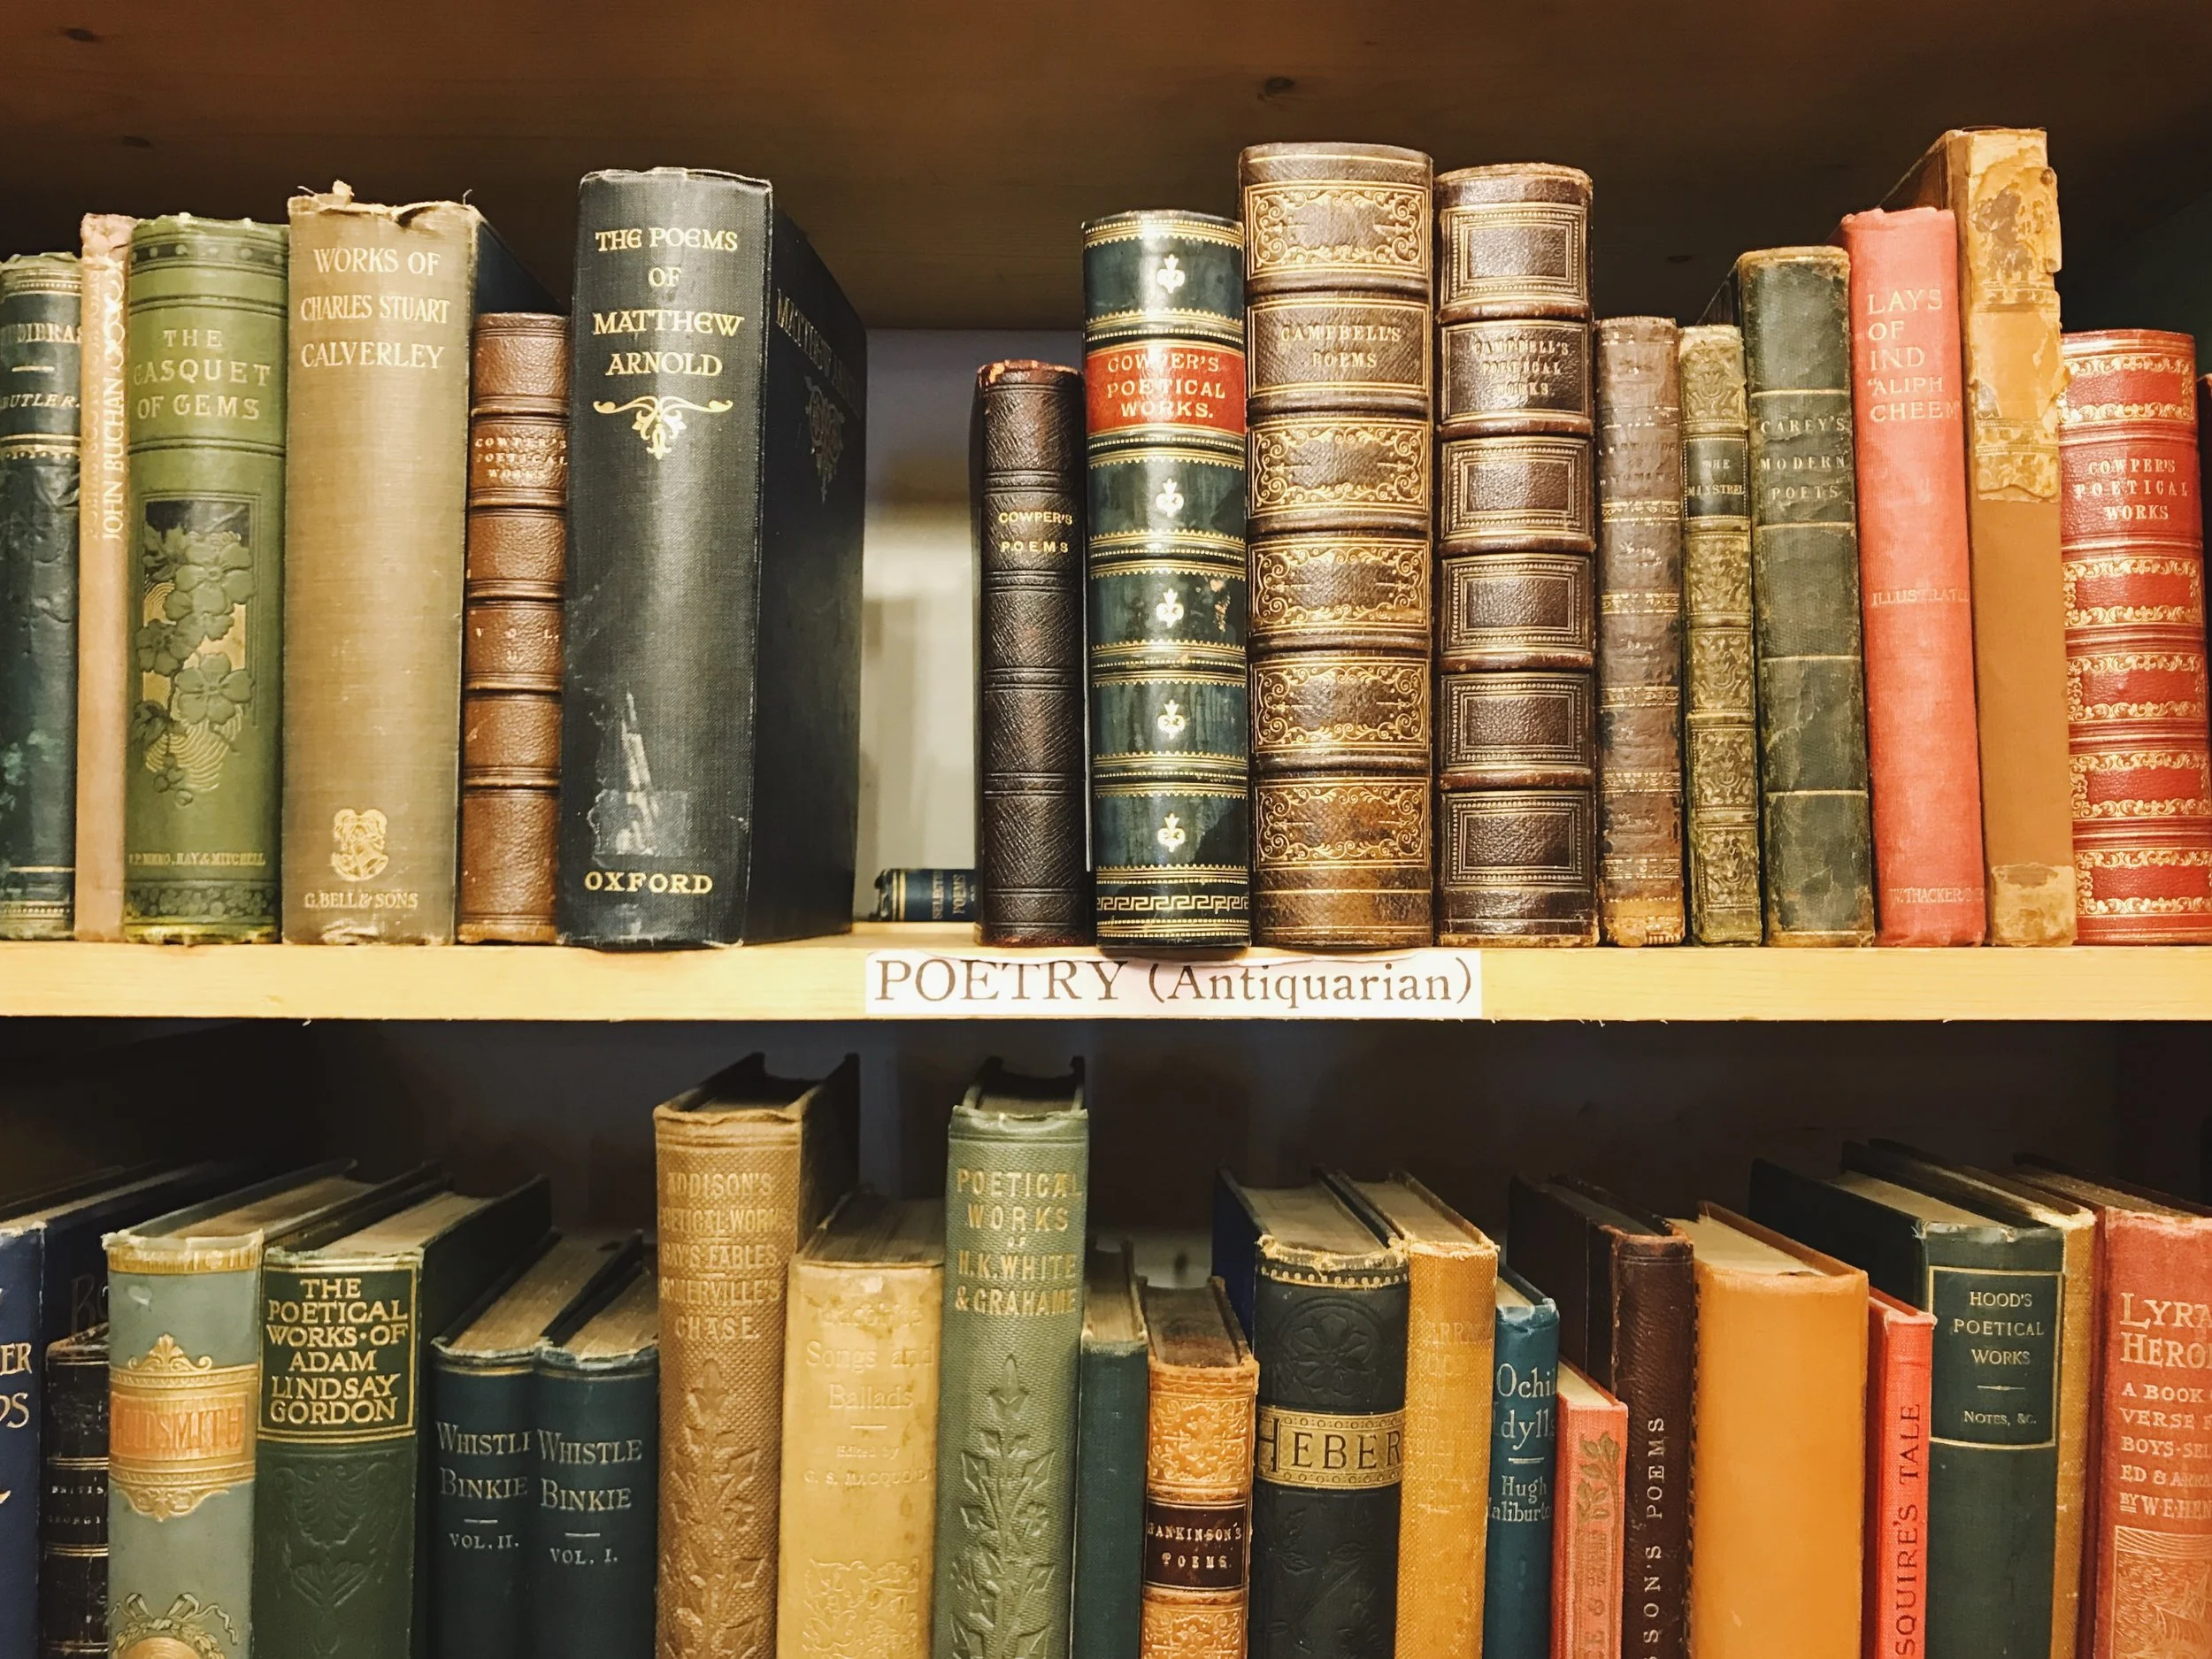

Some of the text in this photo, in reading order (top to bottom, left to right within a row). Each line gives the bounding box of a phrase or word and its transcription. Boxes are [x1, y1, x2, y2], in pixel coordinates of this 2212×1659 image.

[595, 227, 738, 252] THE POEMS
[313, 248, 441, 276] WORKS OF
[648, 267, 682, 288] OF
[301, 295, 450, 324] CHARLES STUART
[1868, 289, 1942, 315] LAYS
[593, 310, 744, 336] MATTHEW
[1280, 325, 1401, 342] CAMPBELL'S
[1868, 320, 1905, 342] OF
[163, 329, 223, 349] THE
[301, 342, 444, 369] CALVERLEY
[605, 352, 723, 377] ARNOLD
[1108, 353, 1219, 373] COWPER'S
[1312, 352, 1377, 369] POEMS
[1870, 347, 1925, 372] IND
[134, 358, 271, 386] CASQUET
[1107, 379, 1225, 398] POETICAL
[138, 396, 259, 420] OF GEMS
[1121, 401, 1214, 419] WORKS.
[103, 377, 124, 541] JOHN BUCHAN
[2089, 458, 2175, 475] COWPER'S
[2074, 480, 2187, 501] POETICAL
[999, 511, 1072, 525] COWPER'S
[2104, 504, 2169, 520] WORKS
[1001, 541, 1068, 553] POEMS
[584, 871, 713, 895] OXFORD
[375, 892, 418, 910] SONS
[875, 956, 1471, 1009] POETRY (Antiquarian)
[966, 1203, 1069, 1232] WORKS
[300, 1279, 362, 1299] THE
[1970, 1290, 2032, 1308] HOOD'S
[268, 1300, 409, 1324] POETICAL
[1954, 1317, 2044, 1337] POETICAL
[288, 1350, 377, 1371] ADAM
[806, 1340, 934, 1373] Songs and
[1970, 1349, 2031, 1365] WORKS
[272, 1373, 401, 1401] LINDSAY
[828, 1384, 914, 1409] Ballads
[2122, 1382, 2137, 1398] A
[2144, 1384, 2204, 1403] BOOK
[270, 1396, 396, 1425] GORDON
[2119, 1408, 2195, 1430] VERSE
[1257, 1417, 1402, 1473] HEBER
[1646, 1417, 1665, 1519] POEMS
[1502, 1475, 1548, 1504] Hugh
[449, 1533, 519, 1549] VOL. II.
[1895, 1403, 1921, 1656] SQUIRE'S TALE
[550, 1548, 618, 1565] VOL. I.
